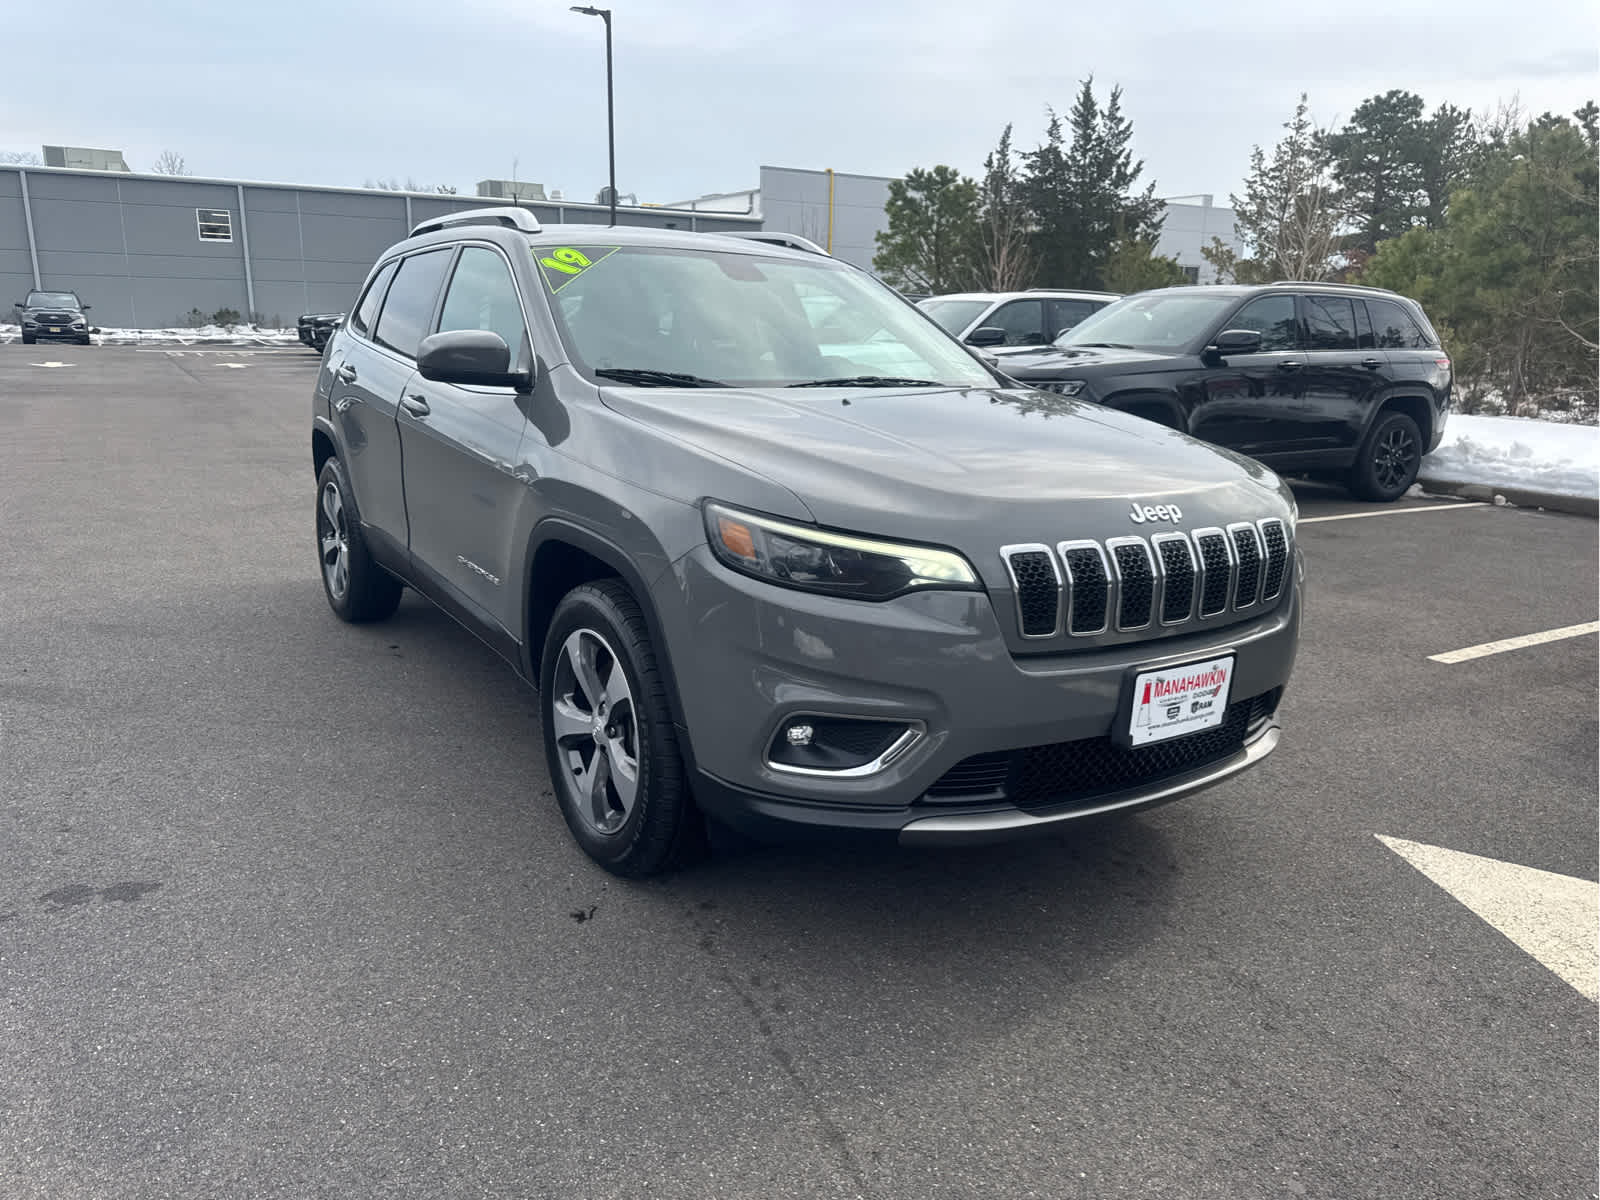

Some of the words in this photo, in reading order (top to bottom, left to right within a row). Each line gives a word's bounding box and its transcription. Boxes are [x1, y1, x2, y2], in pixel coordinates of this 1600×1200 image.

[540, 248, 592, 274] 19
[1129, 502, 1183, 524] Jeep
[1154, 669, 1227, 698] MANAHAWKIN
